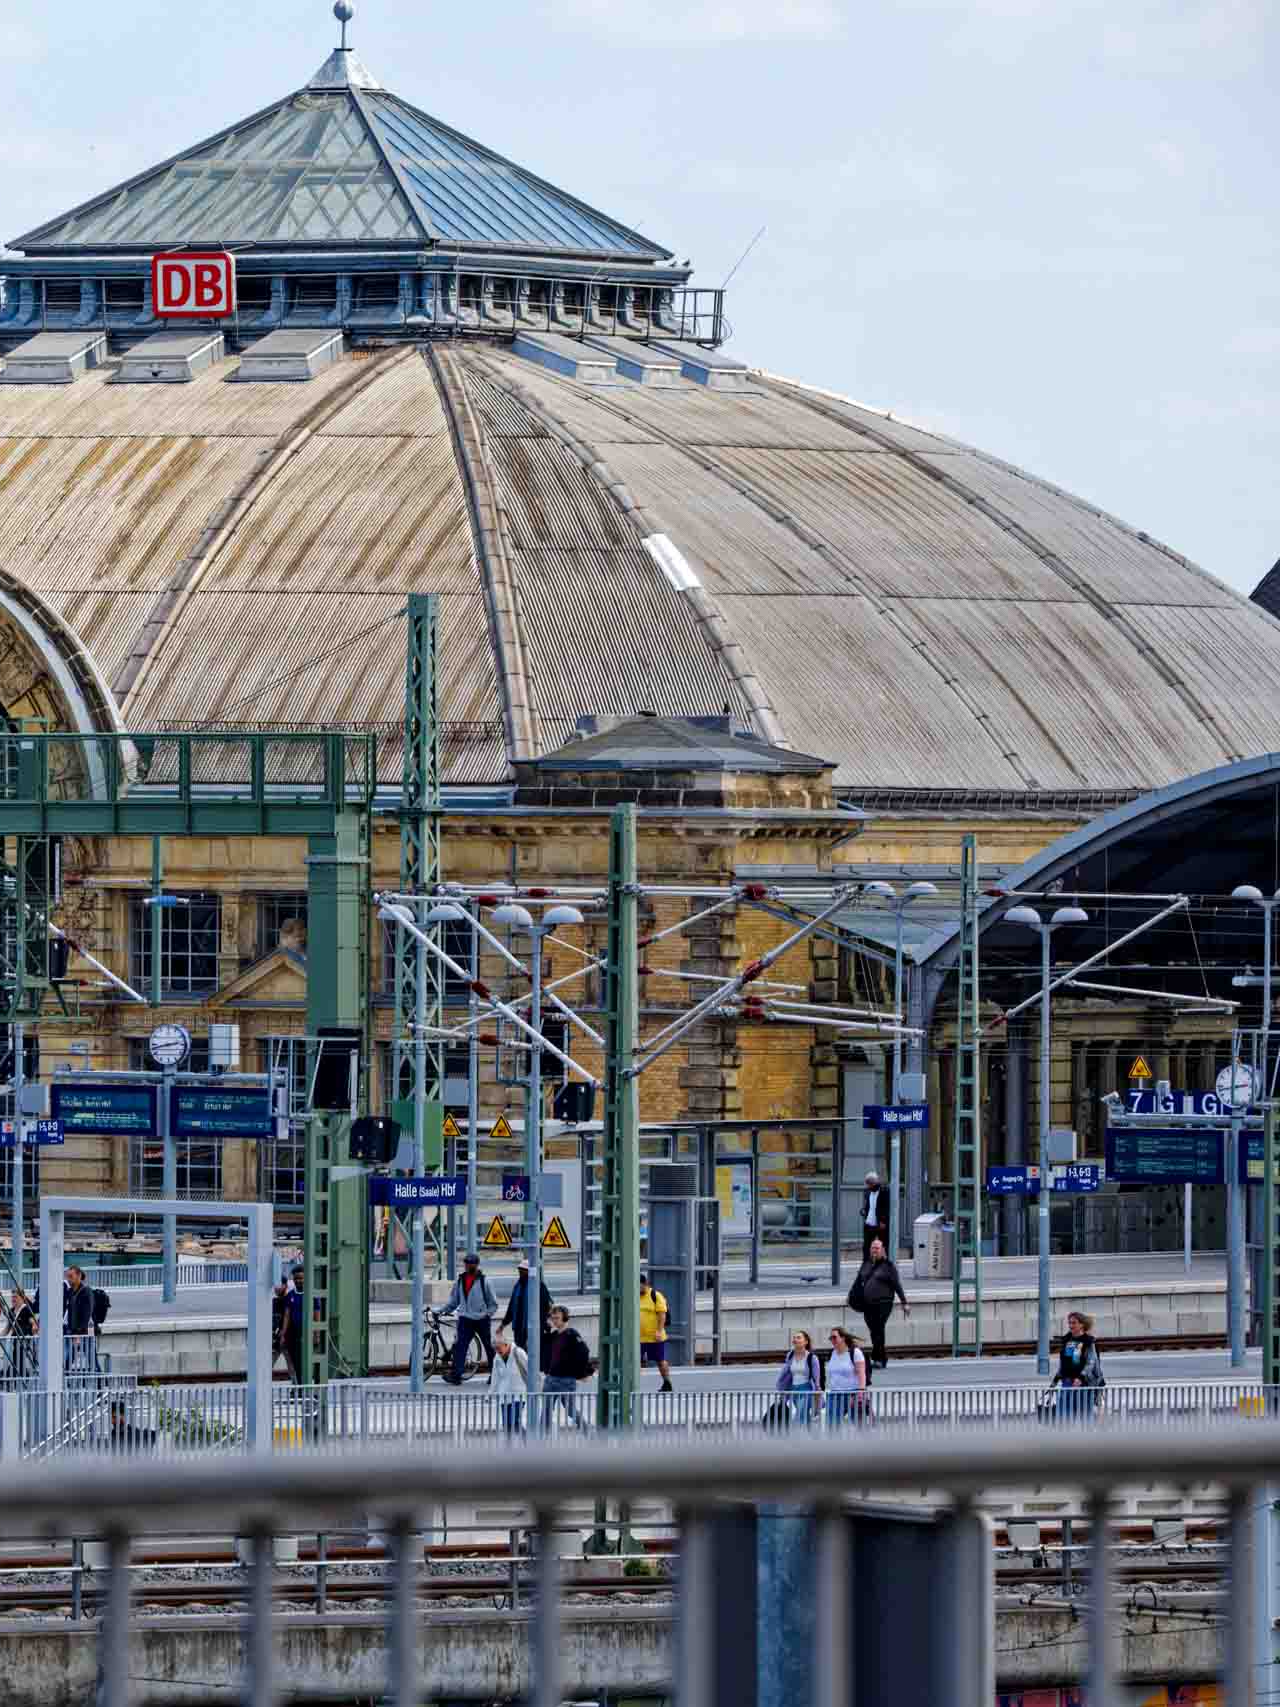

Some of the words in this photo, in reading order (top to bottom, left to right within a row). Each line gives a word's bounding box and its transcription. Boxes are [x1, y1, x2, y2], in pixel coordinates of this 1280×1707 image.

[162, 264, 223, 307] DB
[1130, 1092, 1143, 1113] 7
[1201, 1094, 1218, 1114] G
[395, 1183, 417, 1198] Halle
[419, 1185, 440, 1198] (Saale)
[441, 1182, 456, 1197] Hbf
